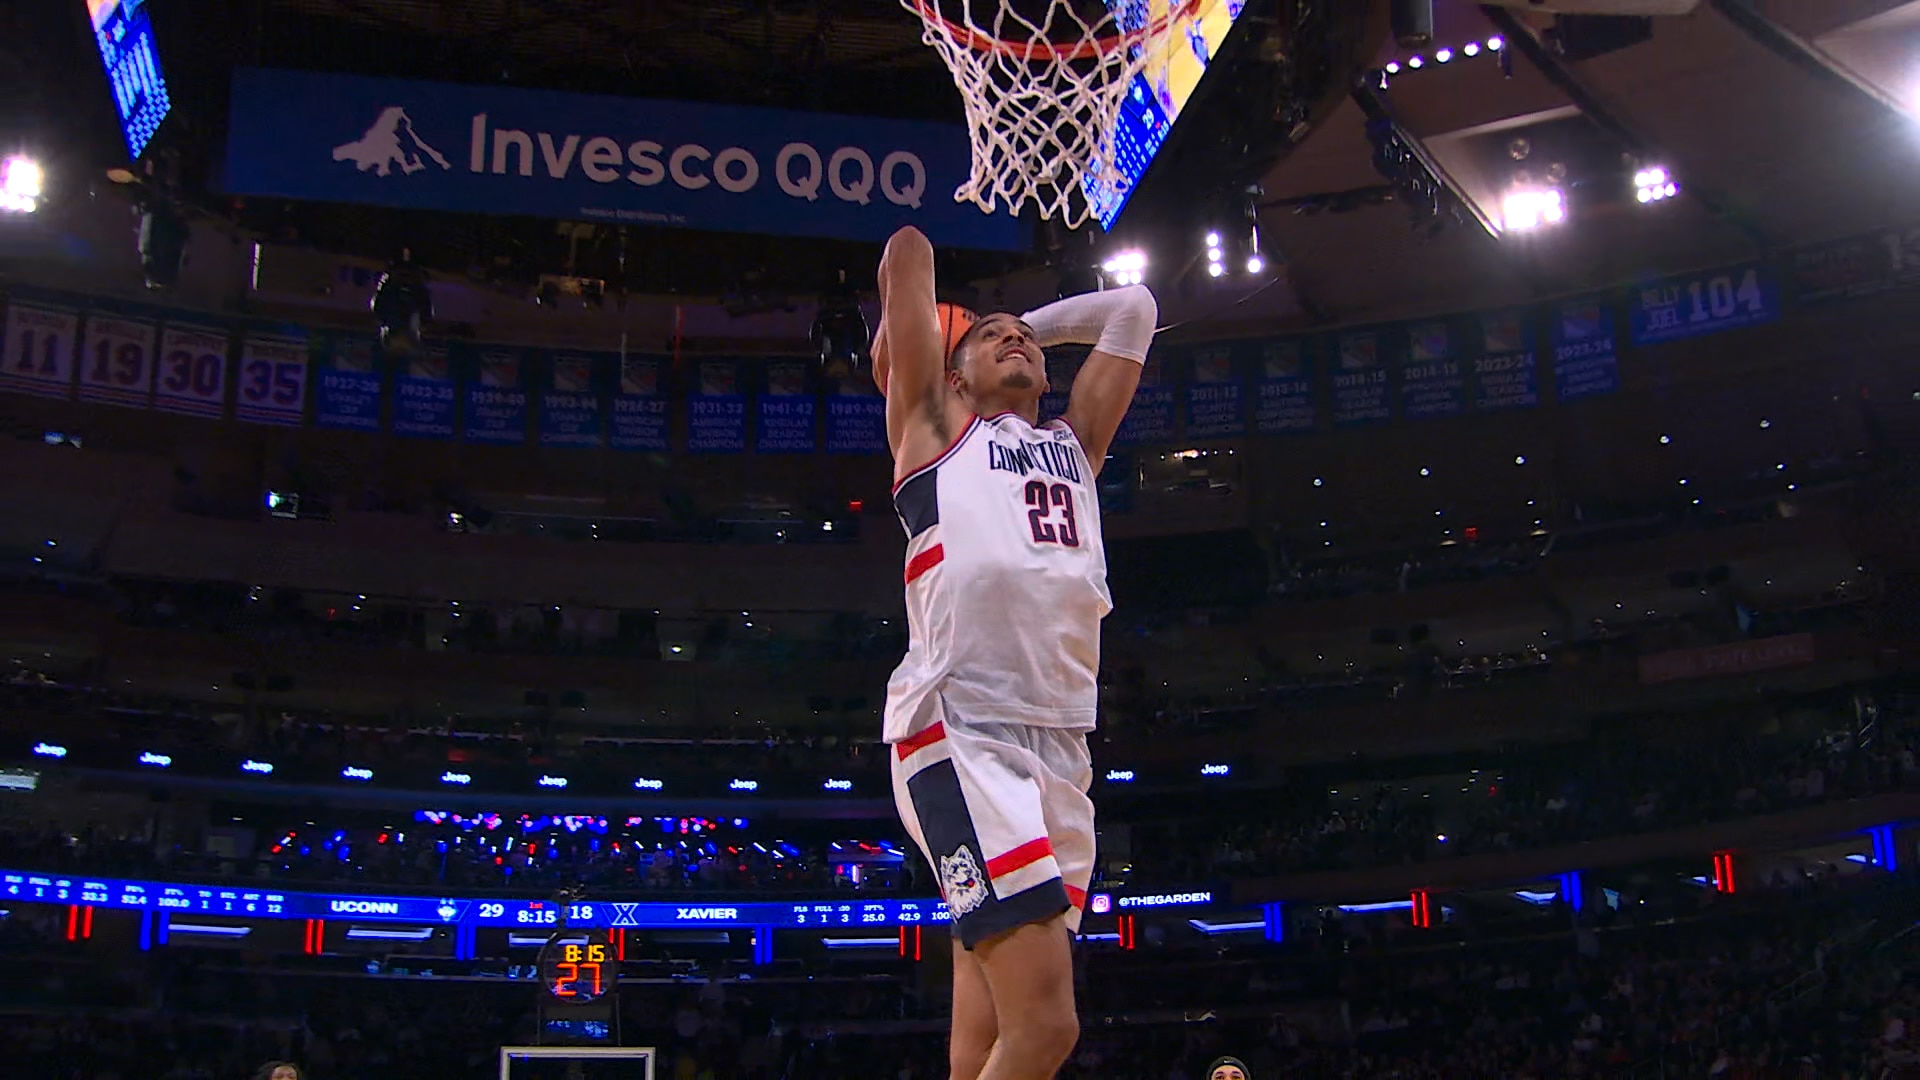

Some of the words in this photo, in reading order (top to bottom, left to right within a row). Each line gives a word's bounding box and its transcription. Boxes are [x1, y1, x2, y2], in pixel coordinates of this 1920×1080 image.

[470, 112, 758, 193] Invesco
[774, 141, 927, 210] QQQ
[1688, 268, 1762, 323] 104
[17, 329, 57, 375] 11
[92, 339, 143, 386] 19
[165, 350, 221, 397] 30
[245, 360, 302, 405] 35
[1025, 480, 1079, 547] 23
[33, 742, 67, 758] Jeep
[140, 751, 172, 767] Jeep
[242, 759, 274, 774] Jeep
[343, 766, 374, 780] Jeep
[1106, 769, 1135, 782] Jeep
[1200, 762, 1230, 776] Jeep
[441, 771, 471, 786] Jeep
[538, 774, 568, 789] Jeep
[634, 777, 663, 791] Jeep
[729, 778, 758, 792] Jeep
[823, 778, 853, 791] Jeep
[35, 887, 43, 897] 1
[57, 889, 69, 899] 3
[81, 891, 108, 902] 33.3
[158, 897, 191, 908] 100.0
[201, 900, 209, 909] 1
[225, 902, 232, 910] 1
[246, 903, 256, 912] 6
[267, 904, 283, 913] 12
[1118, 891, 1212, 907] @THEGARDEN
[331, 900, 399, 914] UCONN
[479, 903, 504, 918] 29
[517, 909, 557, 924] 8:15
[570, 905, 593, 919] 18
[676, 907, 738, 920] XAVIER
[814, 905, 833, 913] FULL
[863, 904, 885, 912] 3PT%
[797, 914, 806, 923] 3
[821, 914, 828, 923] 1
[841, 914, 850, 923] 3
[862, 913, 886, 922] 25.0
[898, 912, 921, 921] 42.9
[931, 911, 950, 921] 100
[565, 944, 605, 962] 8:15
[556, 962, 601, 996] 27
